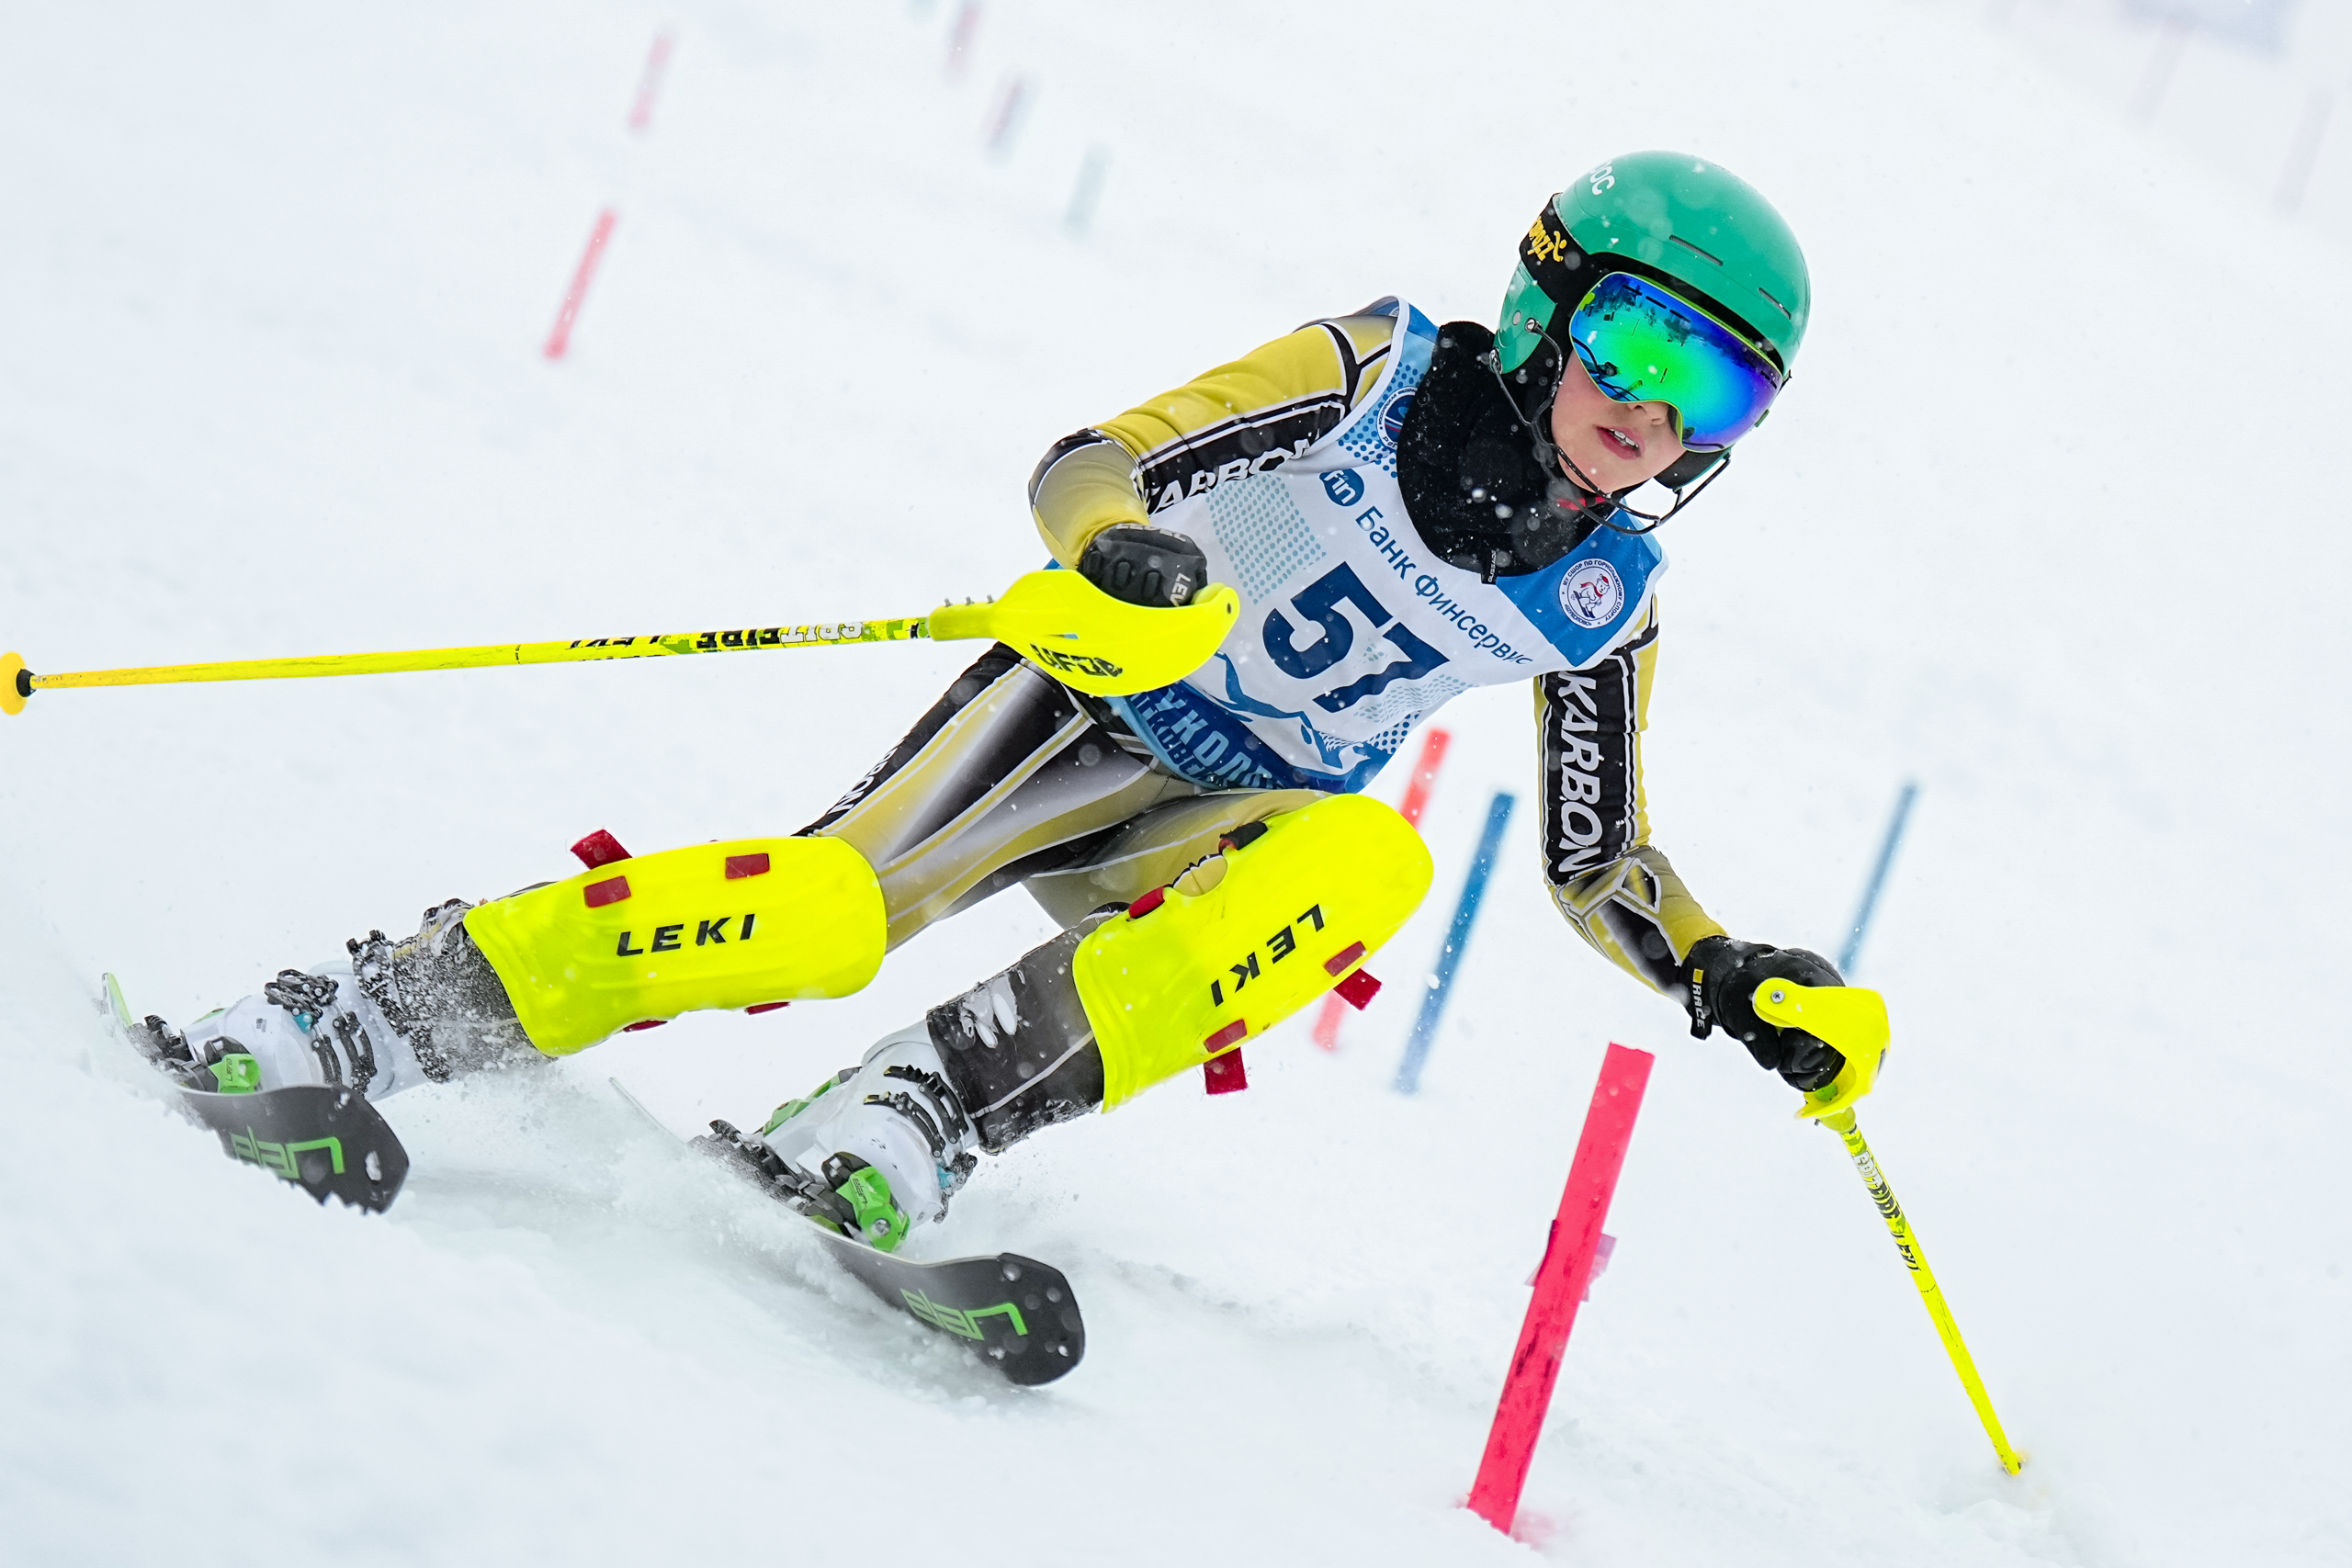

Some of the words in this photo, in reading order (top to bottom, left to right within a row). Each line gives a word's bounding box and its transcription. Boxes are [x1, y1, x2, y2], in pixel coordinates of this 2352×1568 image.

[1170, 572, 1193, 607] LEV
[1354, 505, 1418, 581] Банк
[1415, 573, 1534, 666] Финсервис
[1261, 560, 1451, 714] 57
[1558, 671, 1603, 873] KARBON
[616, 913, 755, 957] LEKI
[1210, 903, 1325, 1008] LEKI
[1692, 983, 1706, 1030] RACE
[231, 1122, 345, 1179] elan
[899, 1288, 1029, 1341] elan
